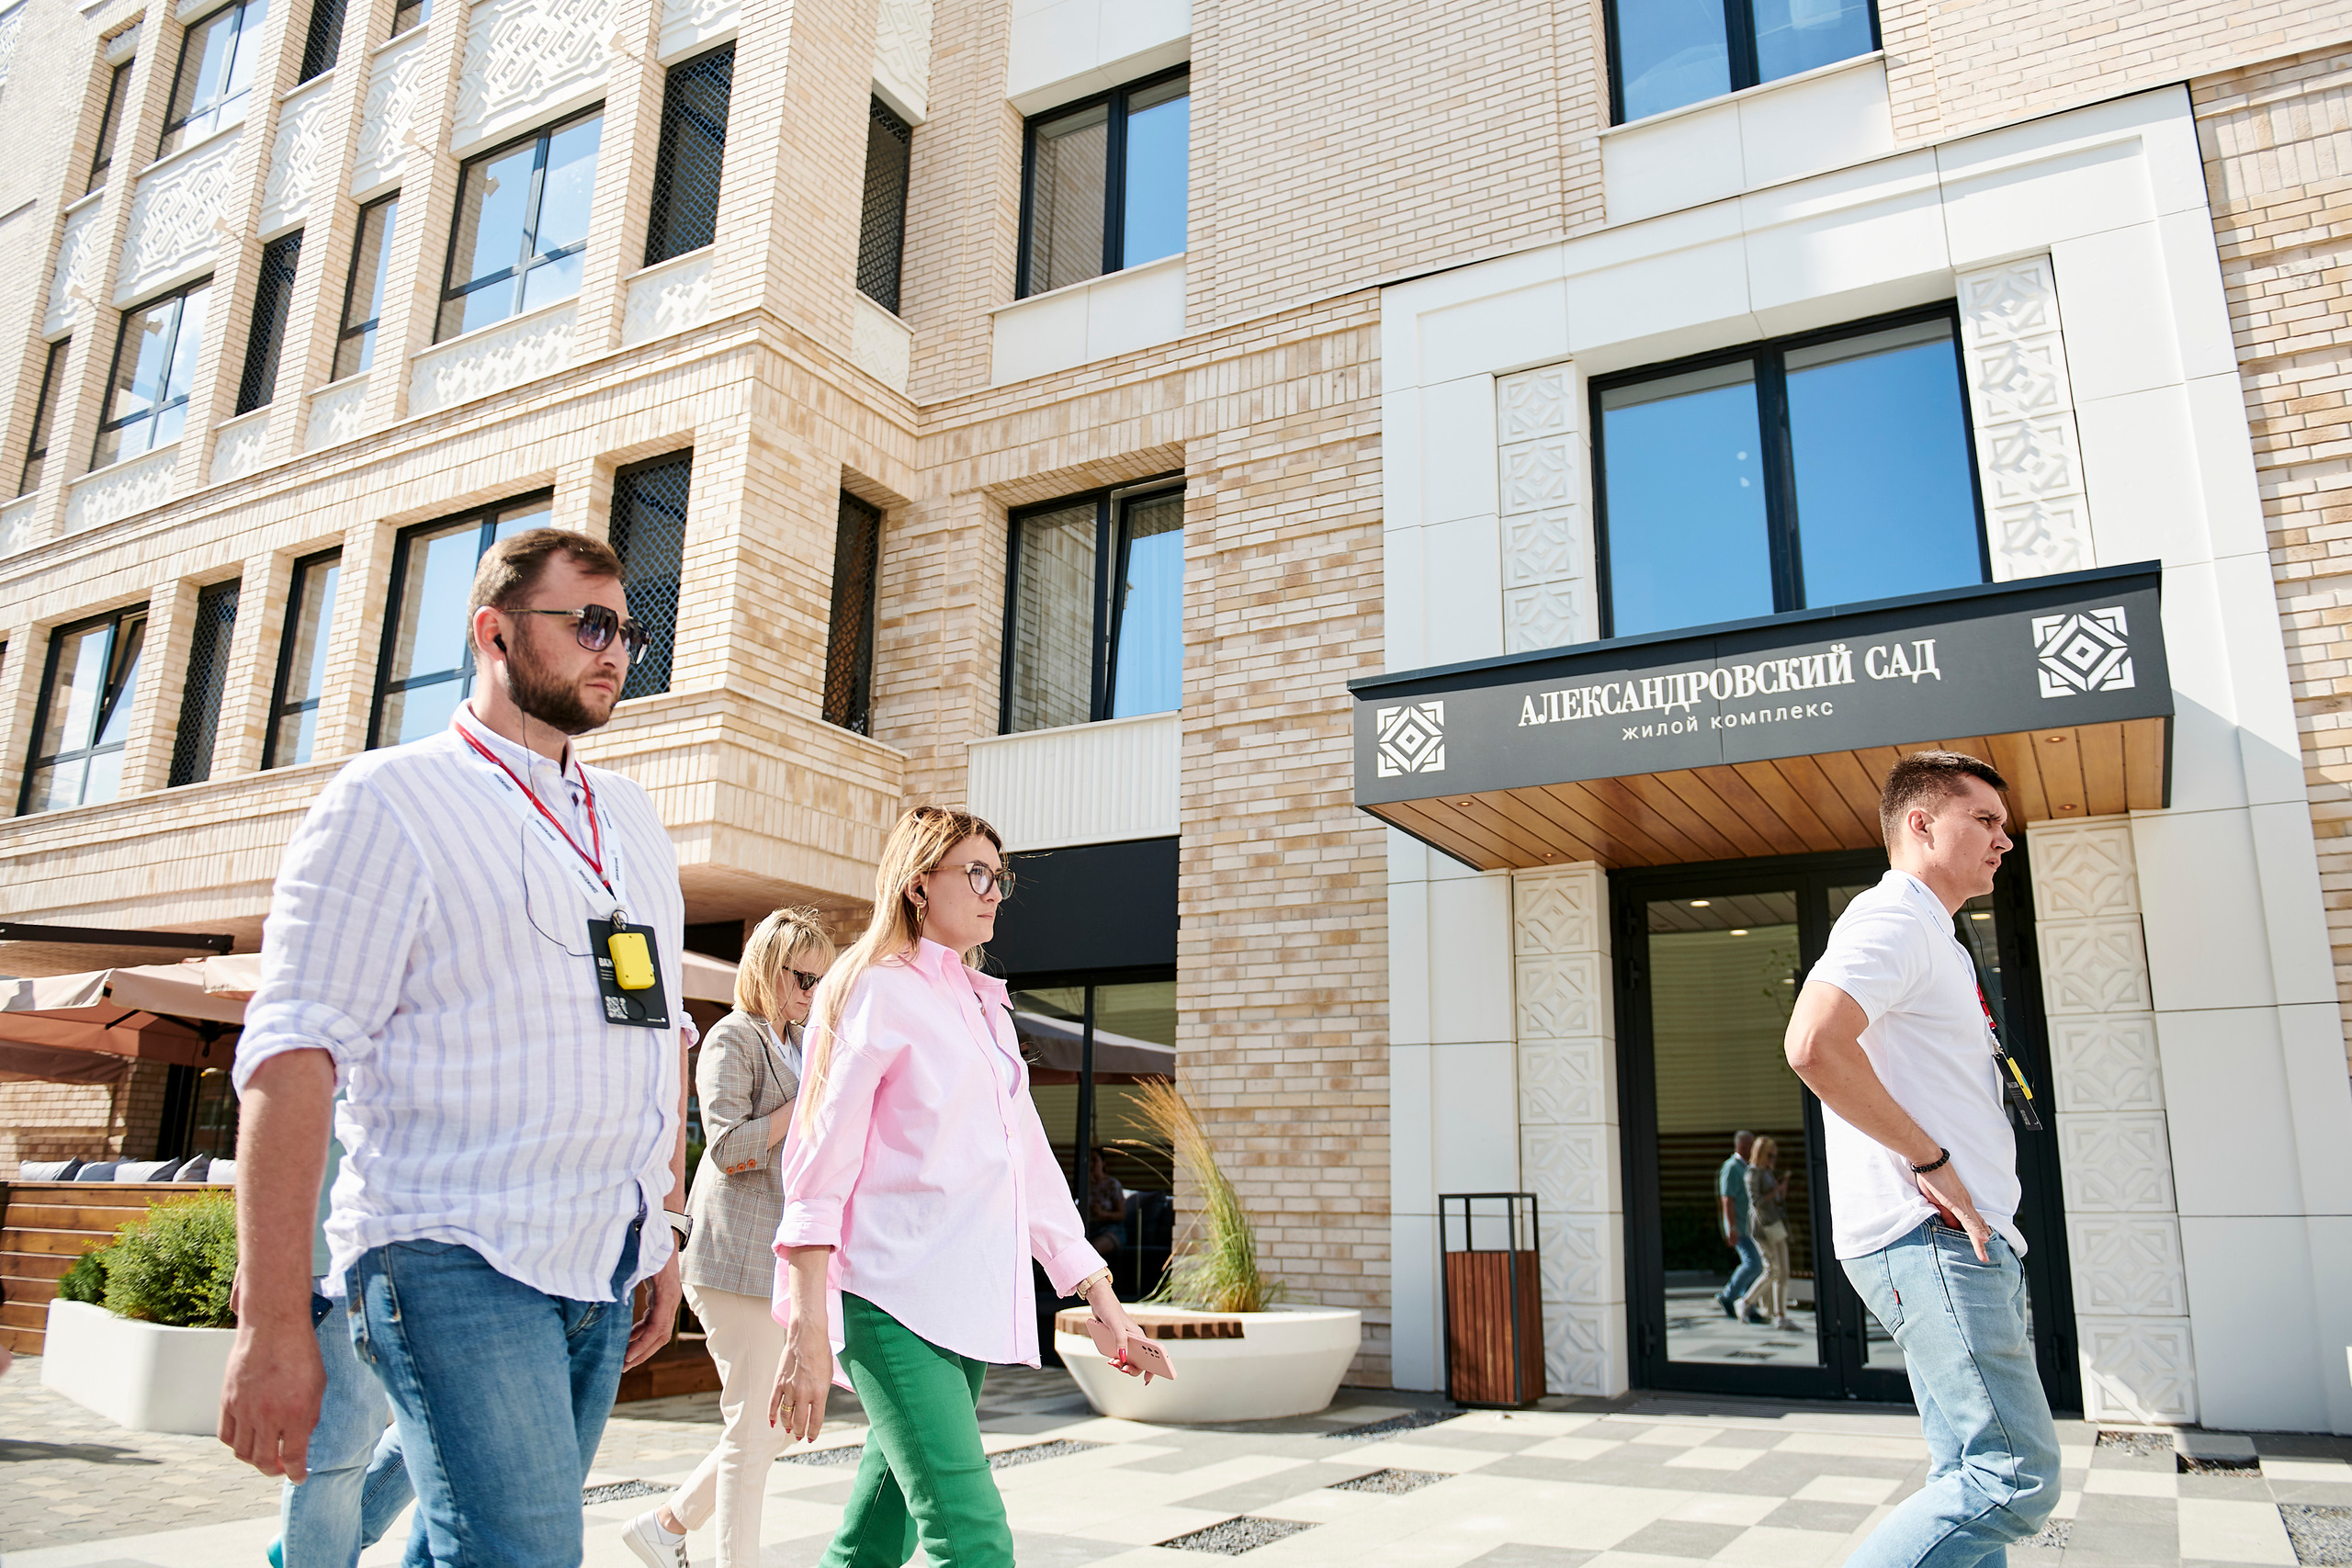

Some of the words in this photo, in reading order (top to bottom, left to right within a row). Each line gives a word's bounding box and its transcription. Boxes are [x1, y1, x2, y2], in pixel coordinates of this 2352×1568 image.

[1517, 643, 1856, 728] АЛЕКСАНДРОВСКИЙ
[1864, 638, 1942, 684] САД
[1621, 715, 1700, 741] жилой
[1710, 701, 1835, 730] комплекс
